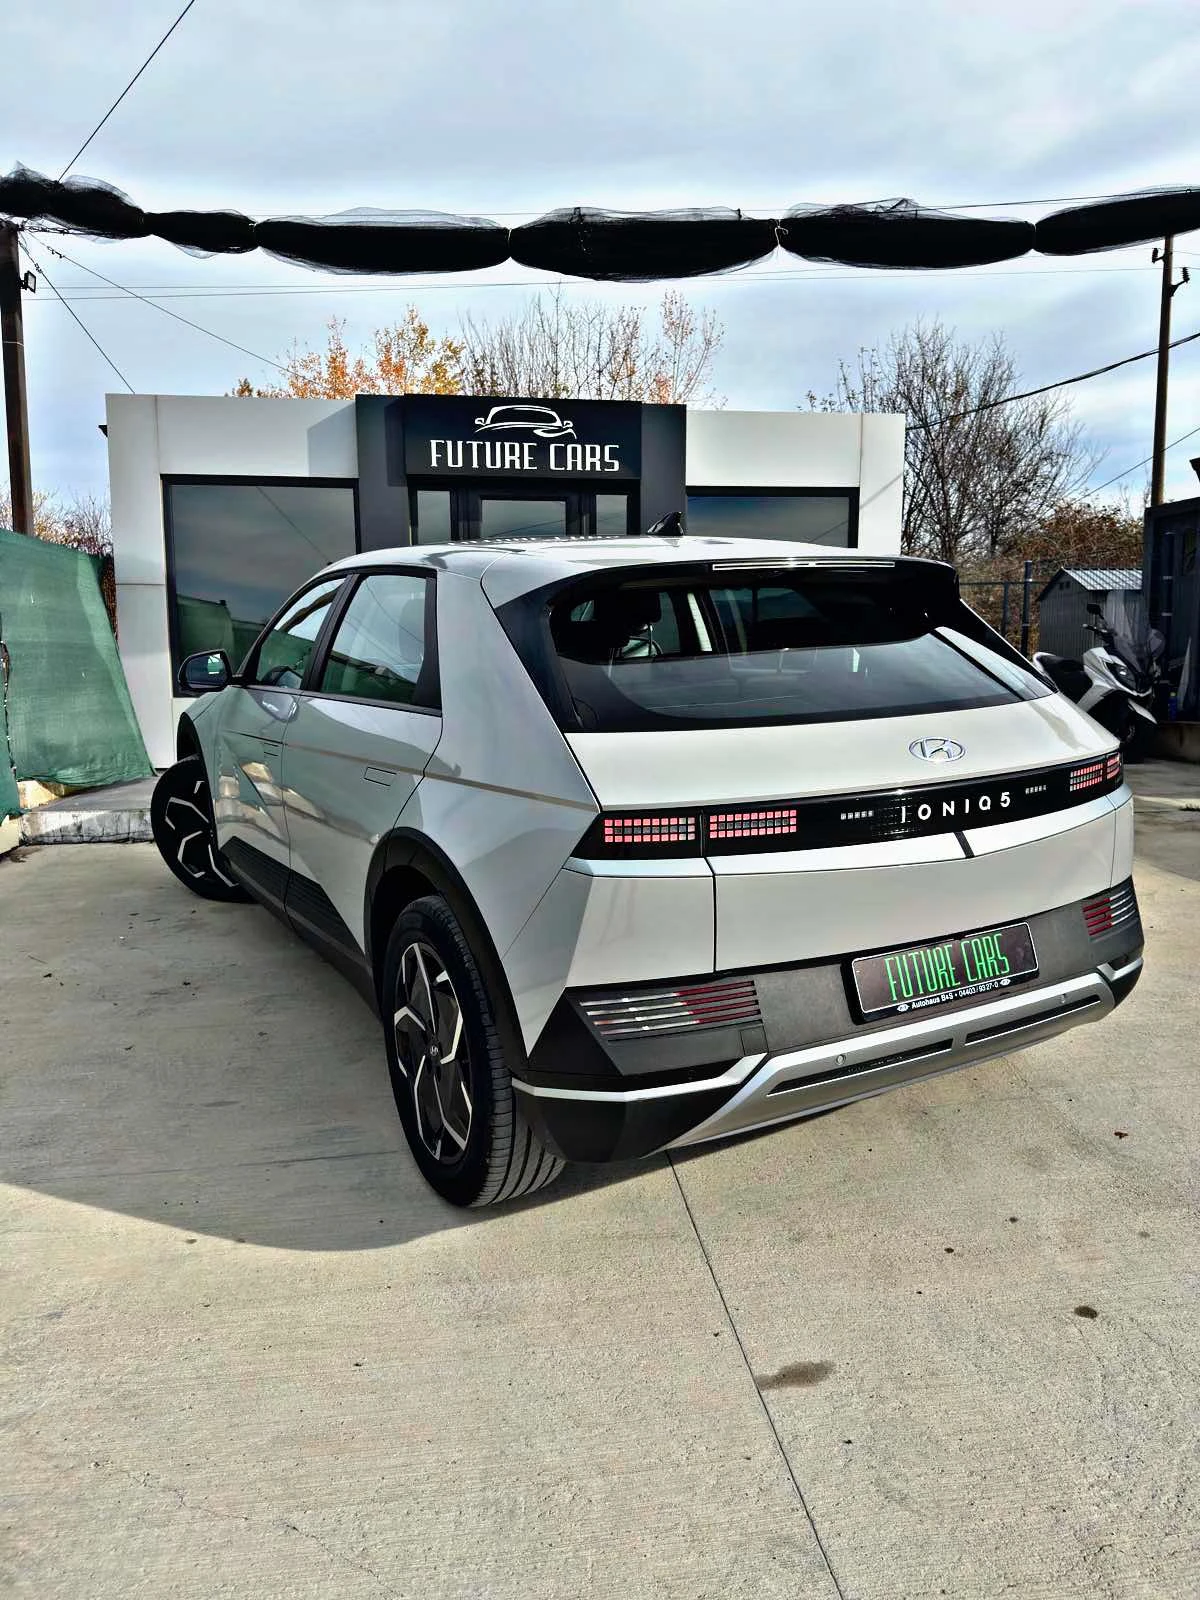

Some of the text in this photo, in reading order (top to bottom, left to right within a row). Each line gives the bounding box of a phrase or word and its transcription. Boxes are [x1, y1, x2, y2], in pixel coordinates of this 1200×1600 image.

[429, 439, 620, 472] FUTURE CARS
[901, 791, 1011, 824] IONIQ 5
[884, 933, 1010, 1001] FUTURE CARS
[911, 996, 941, 1009] Autohaus
